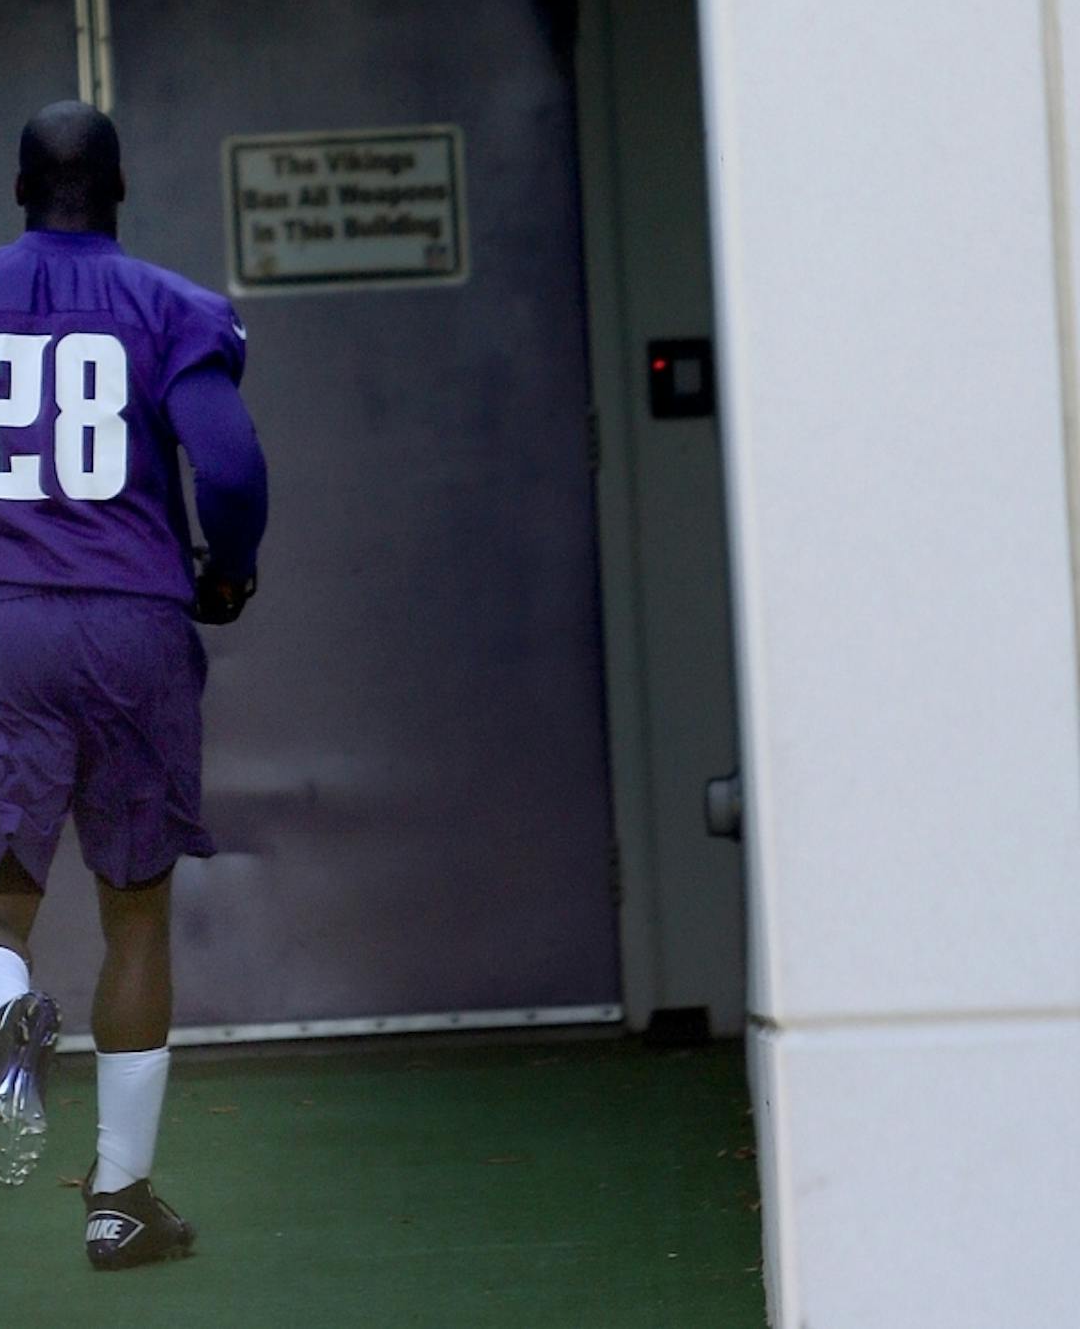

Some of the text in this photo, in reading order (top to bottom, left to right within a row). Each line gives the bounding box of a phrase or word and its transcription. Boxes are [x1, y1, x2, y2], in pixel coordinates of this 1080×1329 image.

[324, 148, 416, 176] Vikings
[282, 219, 335, 243] This
[344, 214, 442, 240] Building
[86, 1218, 123, 1241] NIKE
